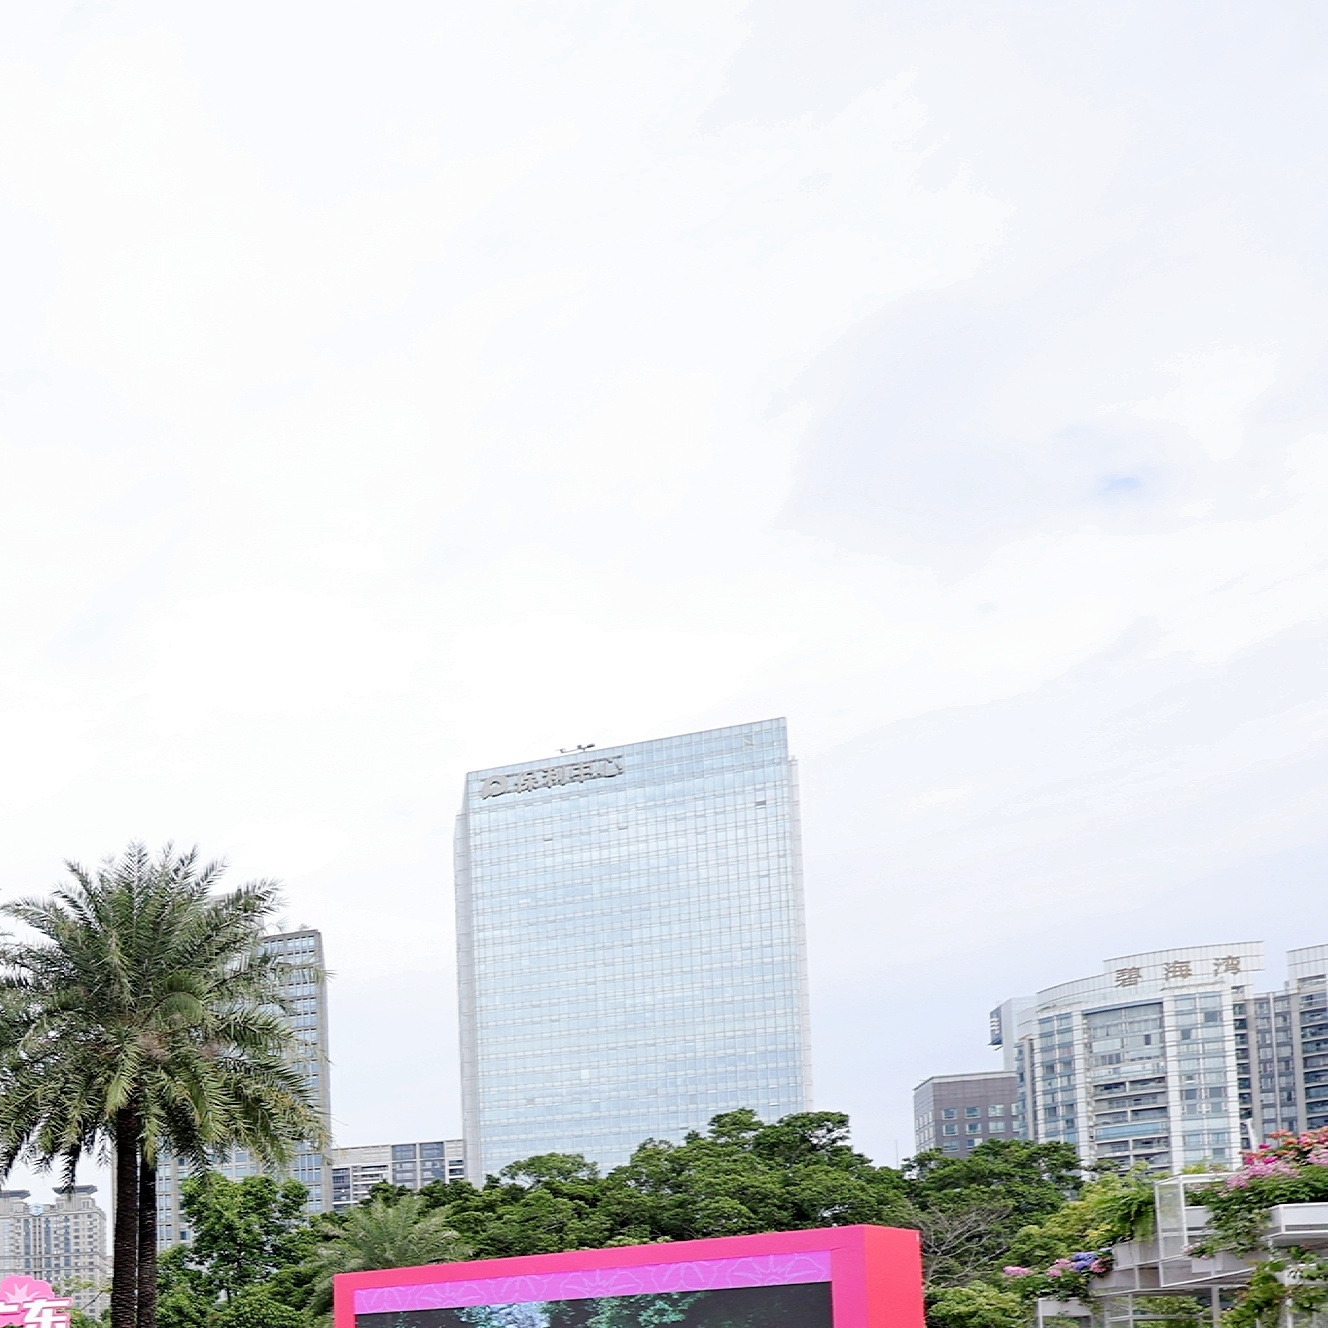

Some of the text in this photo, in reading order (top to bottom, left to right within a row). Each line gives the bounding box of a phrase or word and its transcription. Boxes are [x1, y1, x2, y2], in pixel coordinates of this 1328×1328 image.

[516, 758, 625, 793] 保利中心
[1114, 955, 1241, 988] 碧海湾
